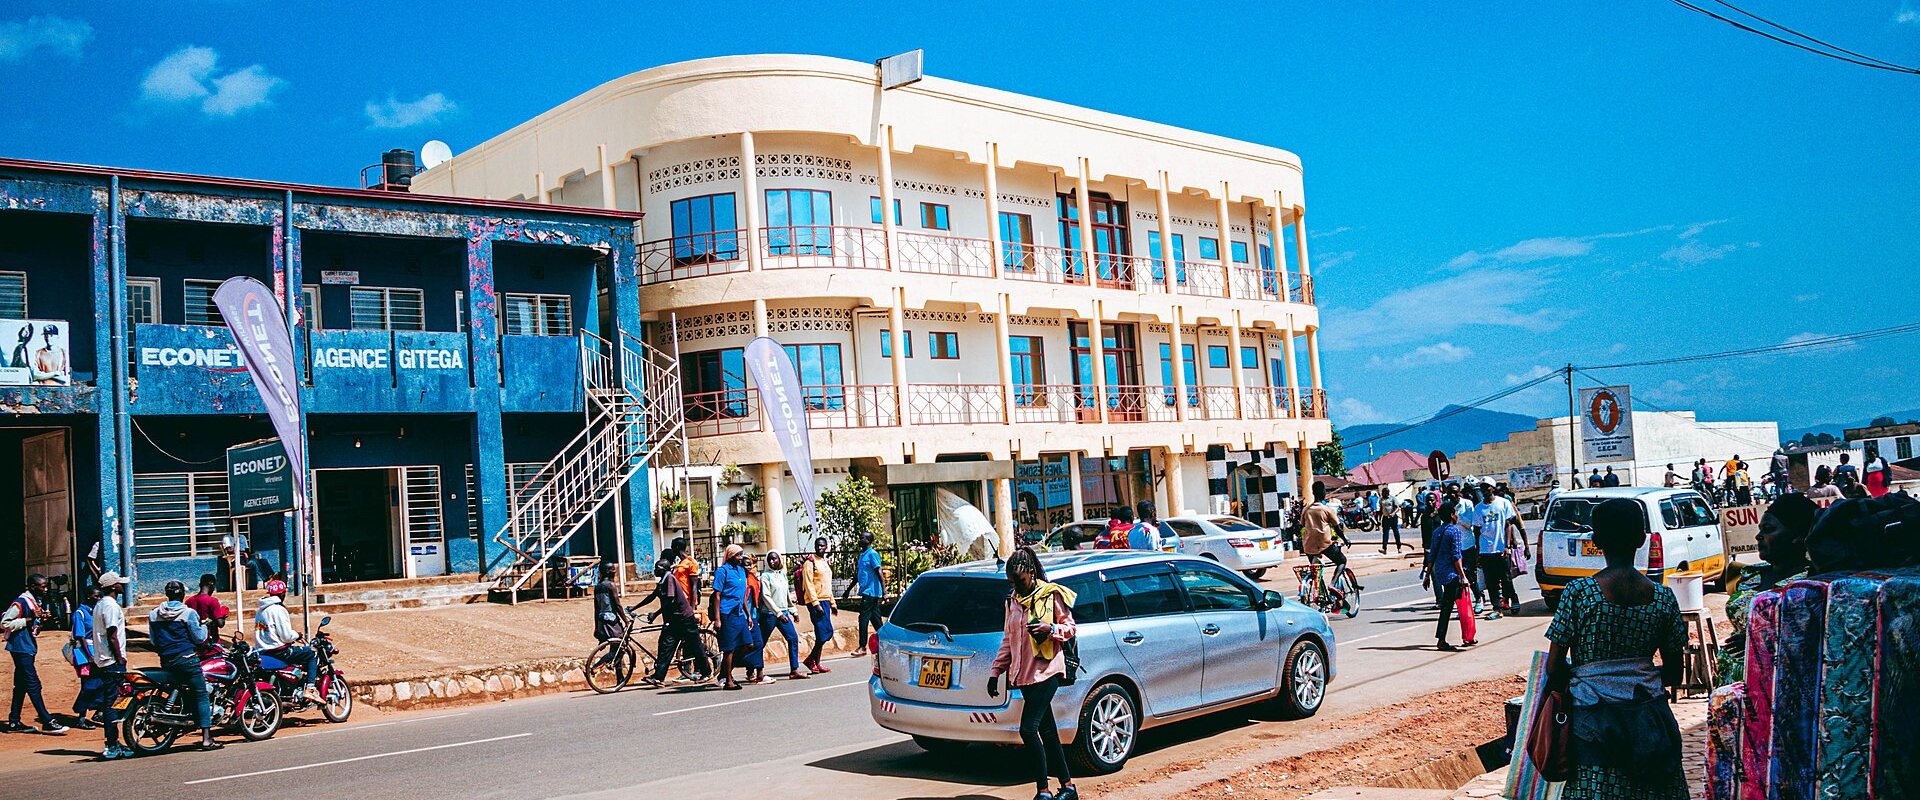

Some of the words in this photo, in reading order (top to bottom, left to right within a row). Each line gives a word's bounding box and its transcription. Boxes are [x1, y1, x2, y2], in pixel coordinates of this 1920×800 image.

[141, 347, 245, 367] ECONET
[314, 348, 388, 369] AGENCE
[398, 349, 464, 369] GITEGA
[233, 455, 282, 476] ECONET
[244, 498, 262, 508] AGENCE
[262, 496, 279, 505] GITEGA
[925, 672, 946, 687] 0985
